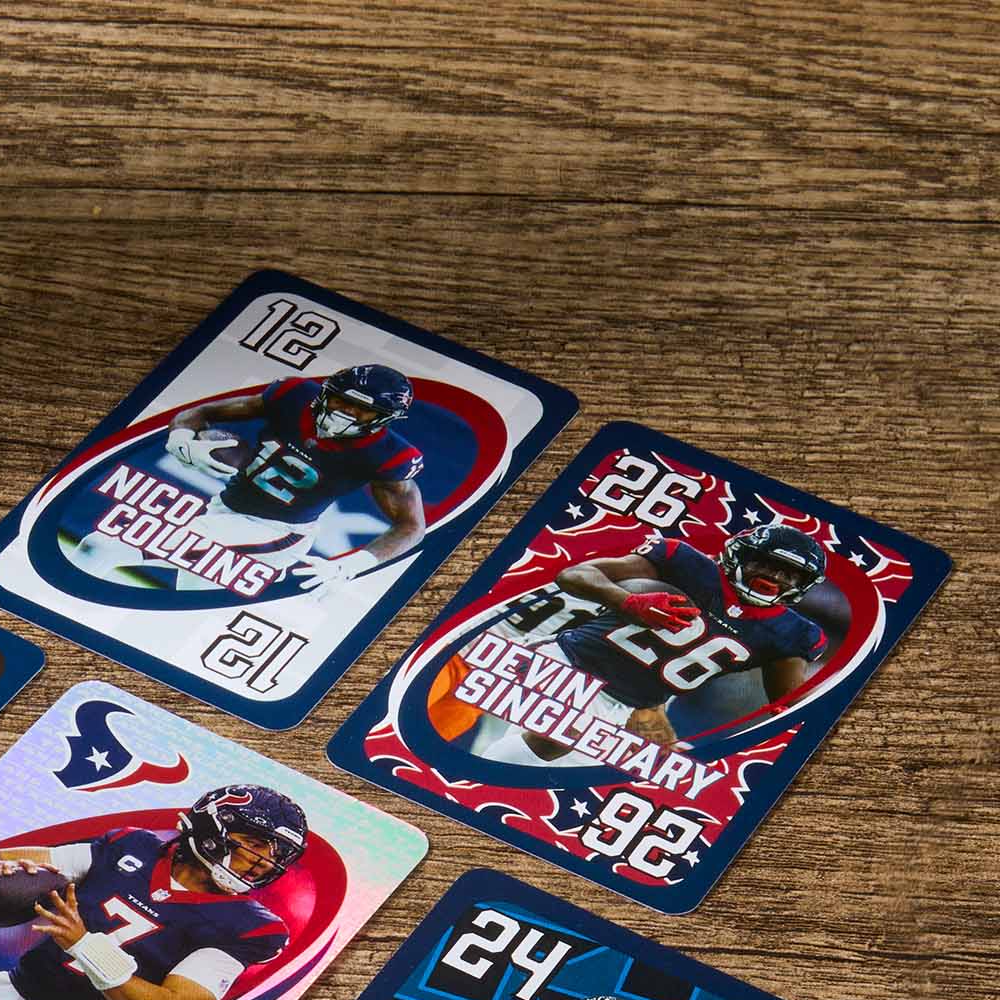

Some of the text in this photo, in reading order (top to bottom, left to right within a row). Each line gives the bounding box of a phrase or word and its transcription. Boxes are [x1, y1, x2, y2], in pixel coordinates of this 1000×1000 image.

[239, 298, 341, 371] 12
[97, 464, 205, 522] NICO
[246, 440, 319, 503] 12
[589, 454, 702, 530] 26
[96, 501, 279, 599] COLLINS
[200, 611, 310, 695] 12
[466, 632, 605, 706] DEVIN
[606, 614, 751, 691] 26
[454, 668, 727, 801] SINGLETARY
[581, 790, 703, 881] 26
[127, 894, 160, 918] TEXANS
